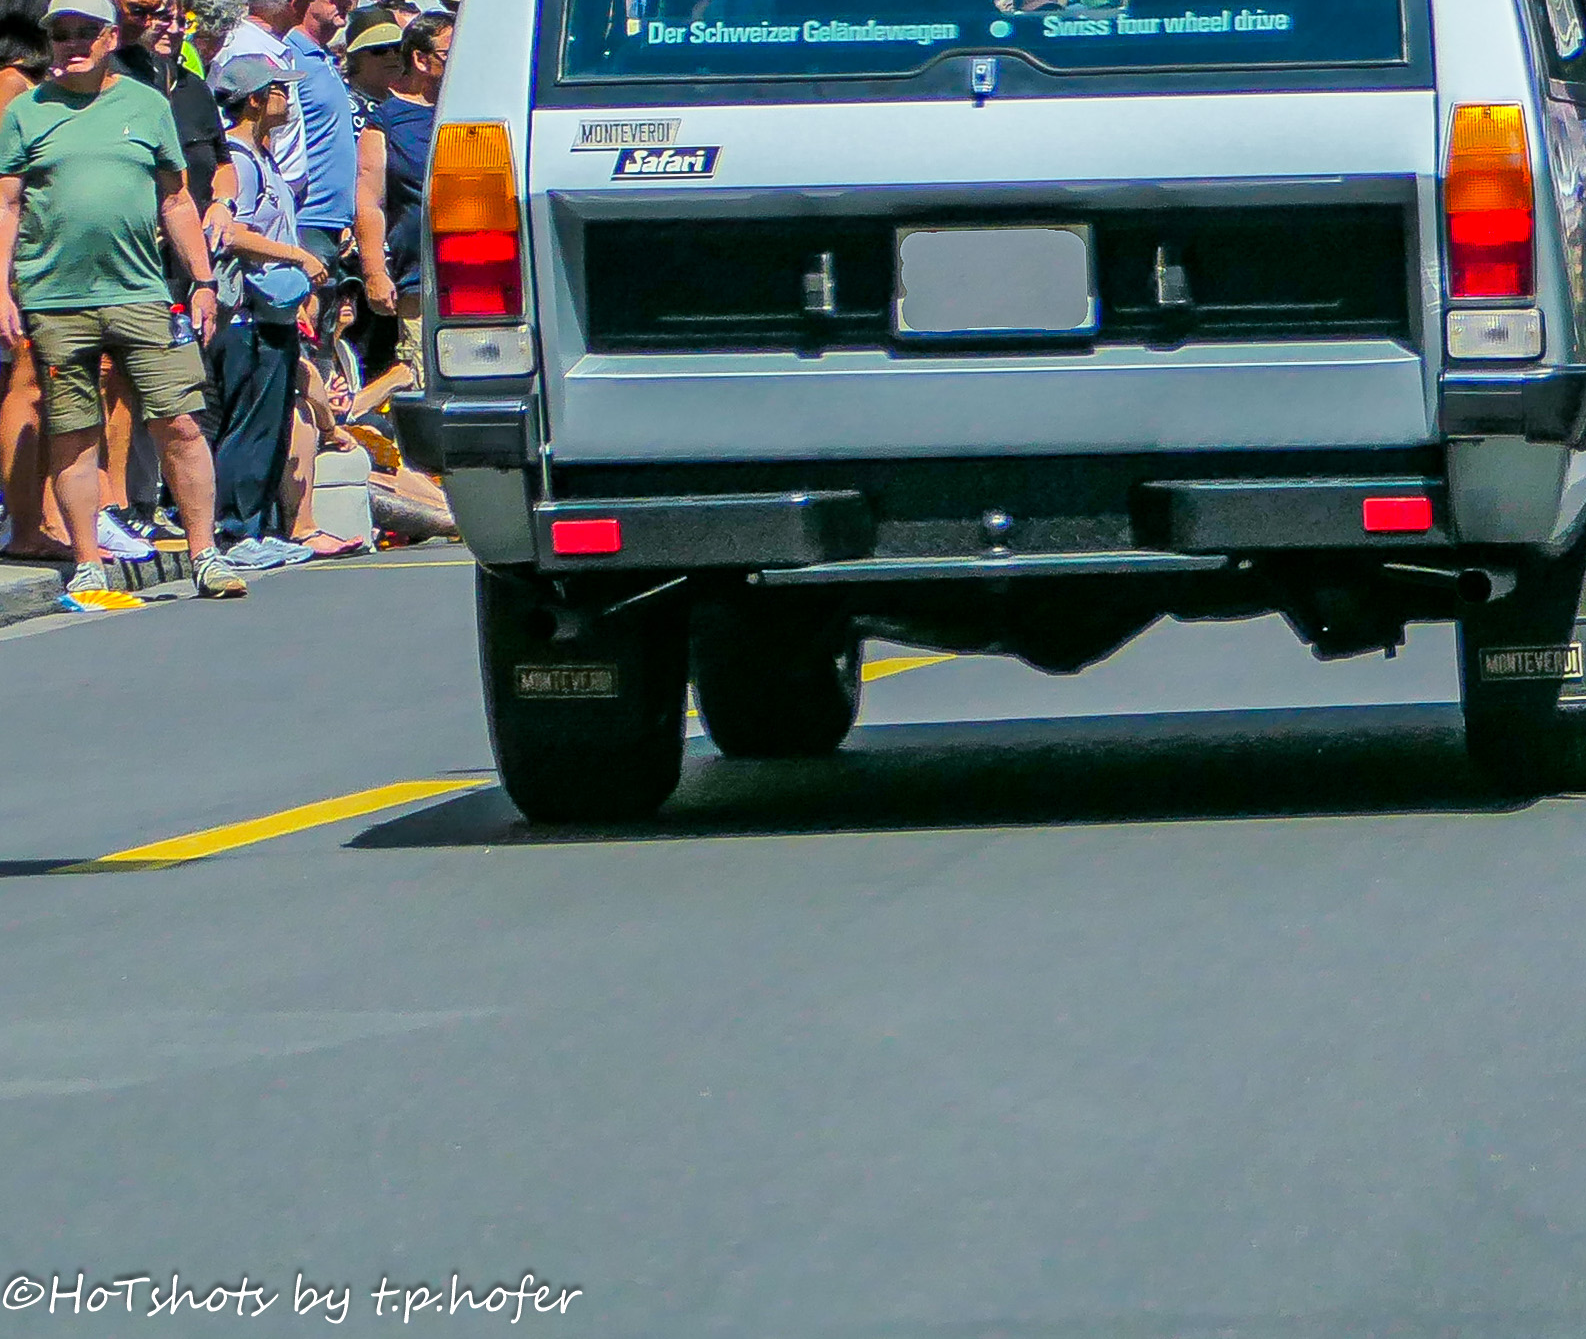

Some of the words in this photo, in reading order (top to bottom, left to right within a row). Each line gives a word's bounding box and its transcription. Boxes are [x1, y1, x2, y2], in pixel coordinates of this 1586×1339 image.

[648, 21, 687, 44] Der
[689, 20, 801, 44] Schweizer
[803, 19, 959, 46] Geländewagen
[1043, 14, 1112, 37] Swiss
[1116, 14, 1162, 35] four
[1163, 10, 1232, 33] wheel
[1233, 9, 1291, 32] drive
[581, 122, 671, 144] MONTEVERDI
[623, 149, 707, 173] Safari
[1485, 649, 1578, 674] MONTEVERDI
